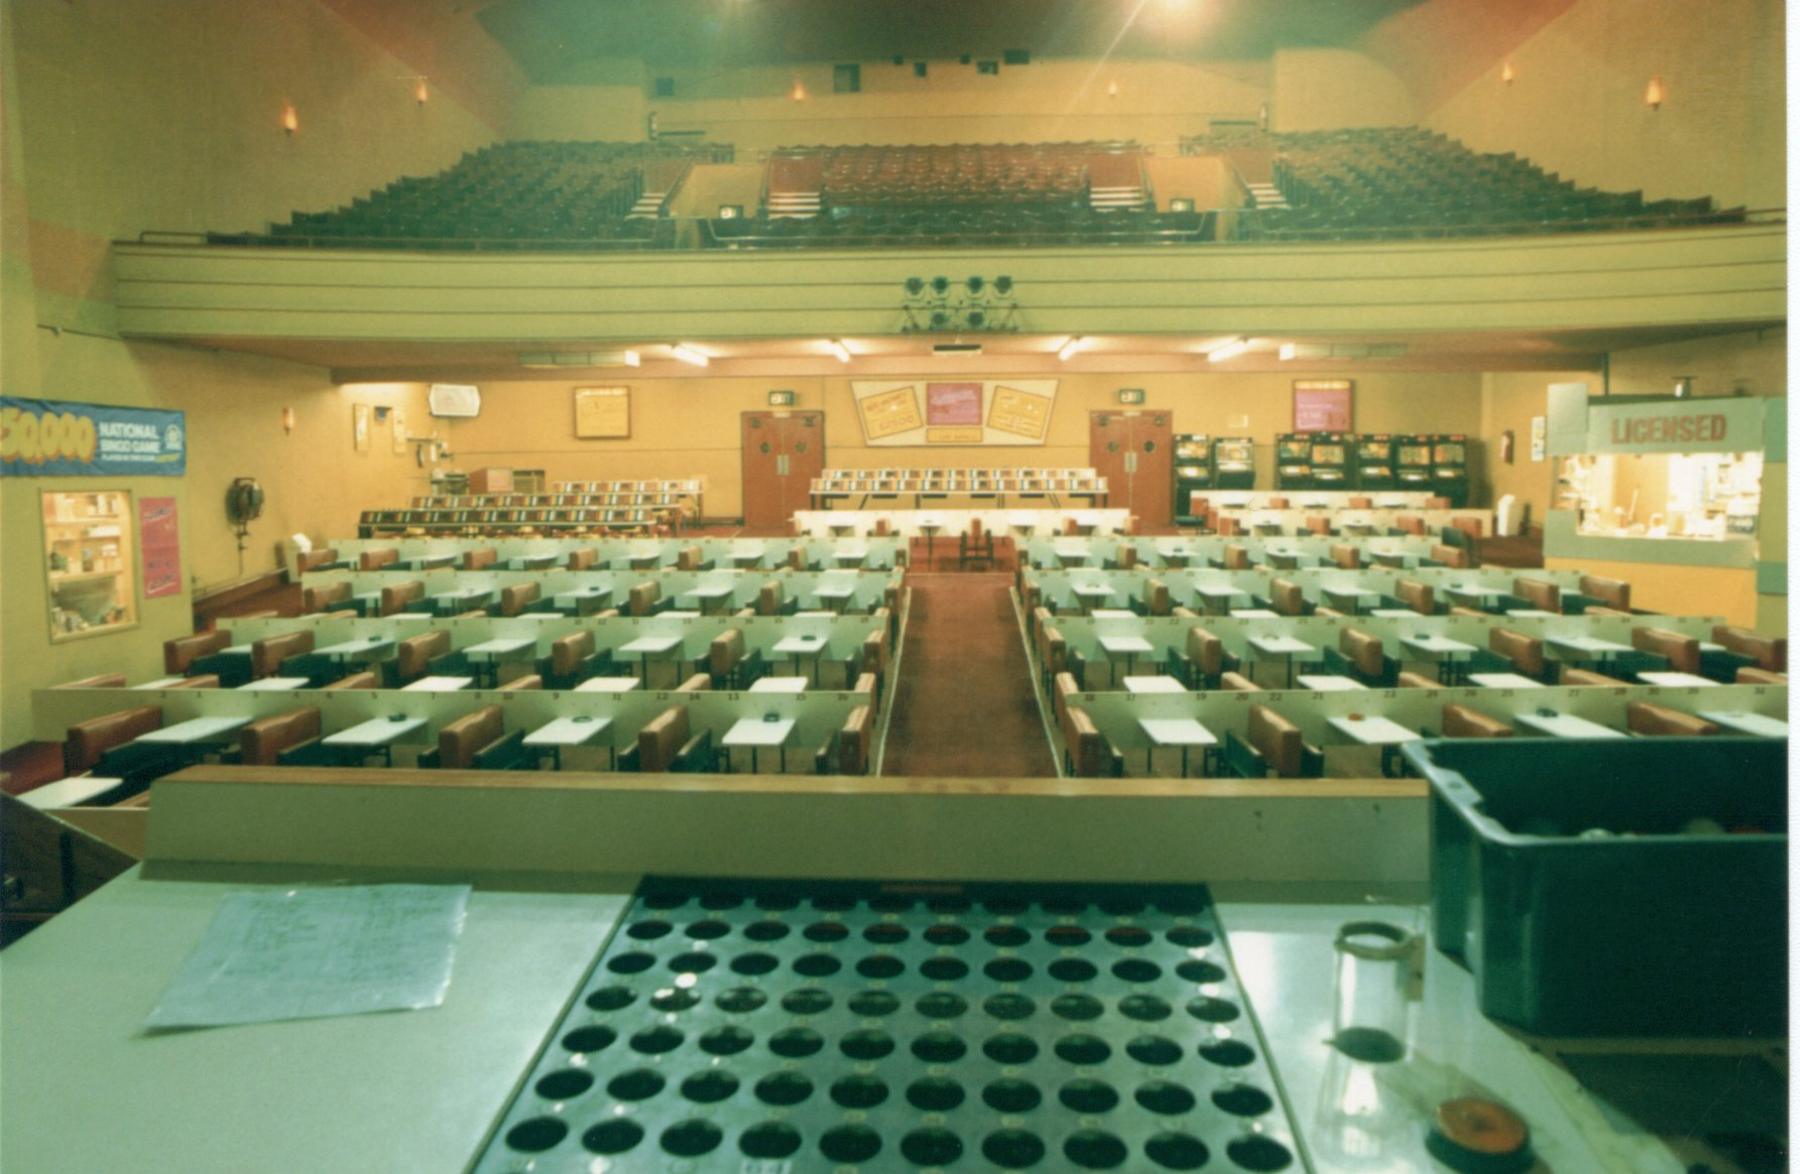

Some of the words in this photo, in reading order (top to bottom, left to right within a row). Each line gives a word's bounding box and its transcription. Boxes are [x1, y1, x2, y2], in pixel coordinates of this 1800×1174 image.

[99, 422, 159, 439] NATIONAL
[1611, 414, 1726, 443] LICENSED
[100, 439, 131, 453] BINGO
[133, 440, 160, 453] GAME
